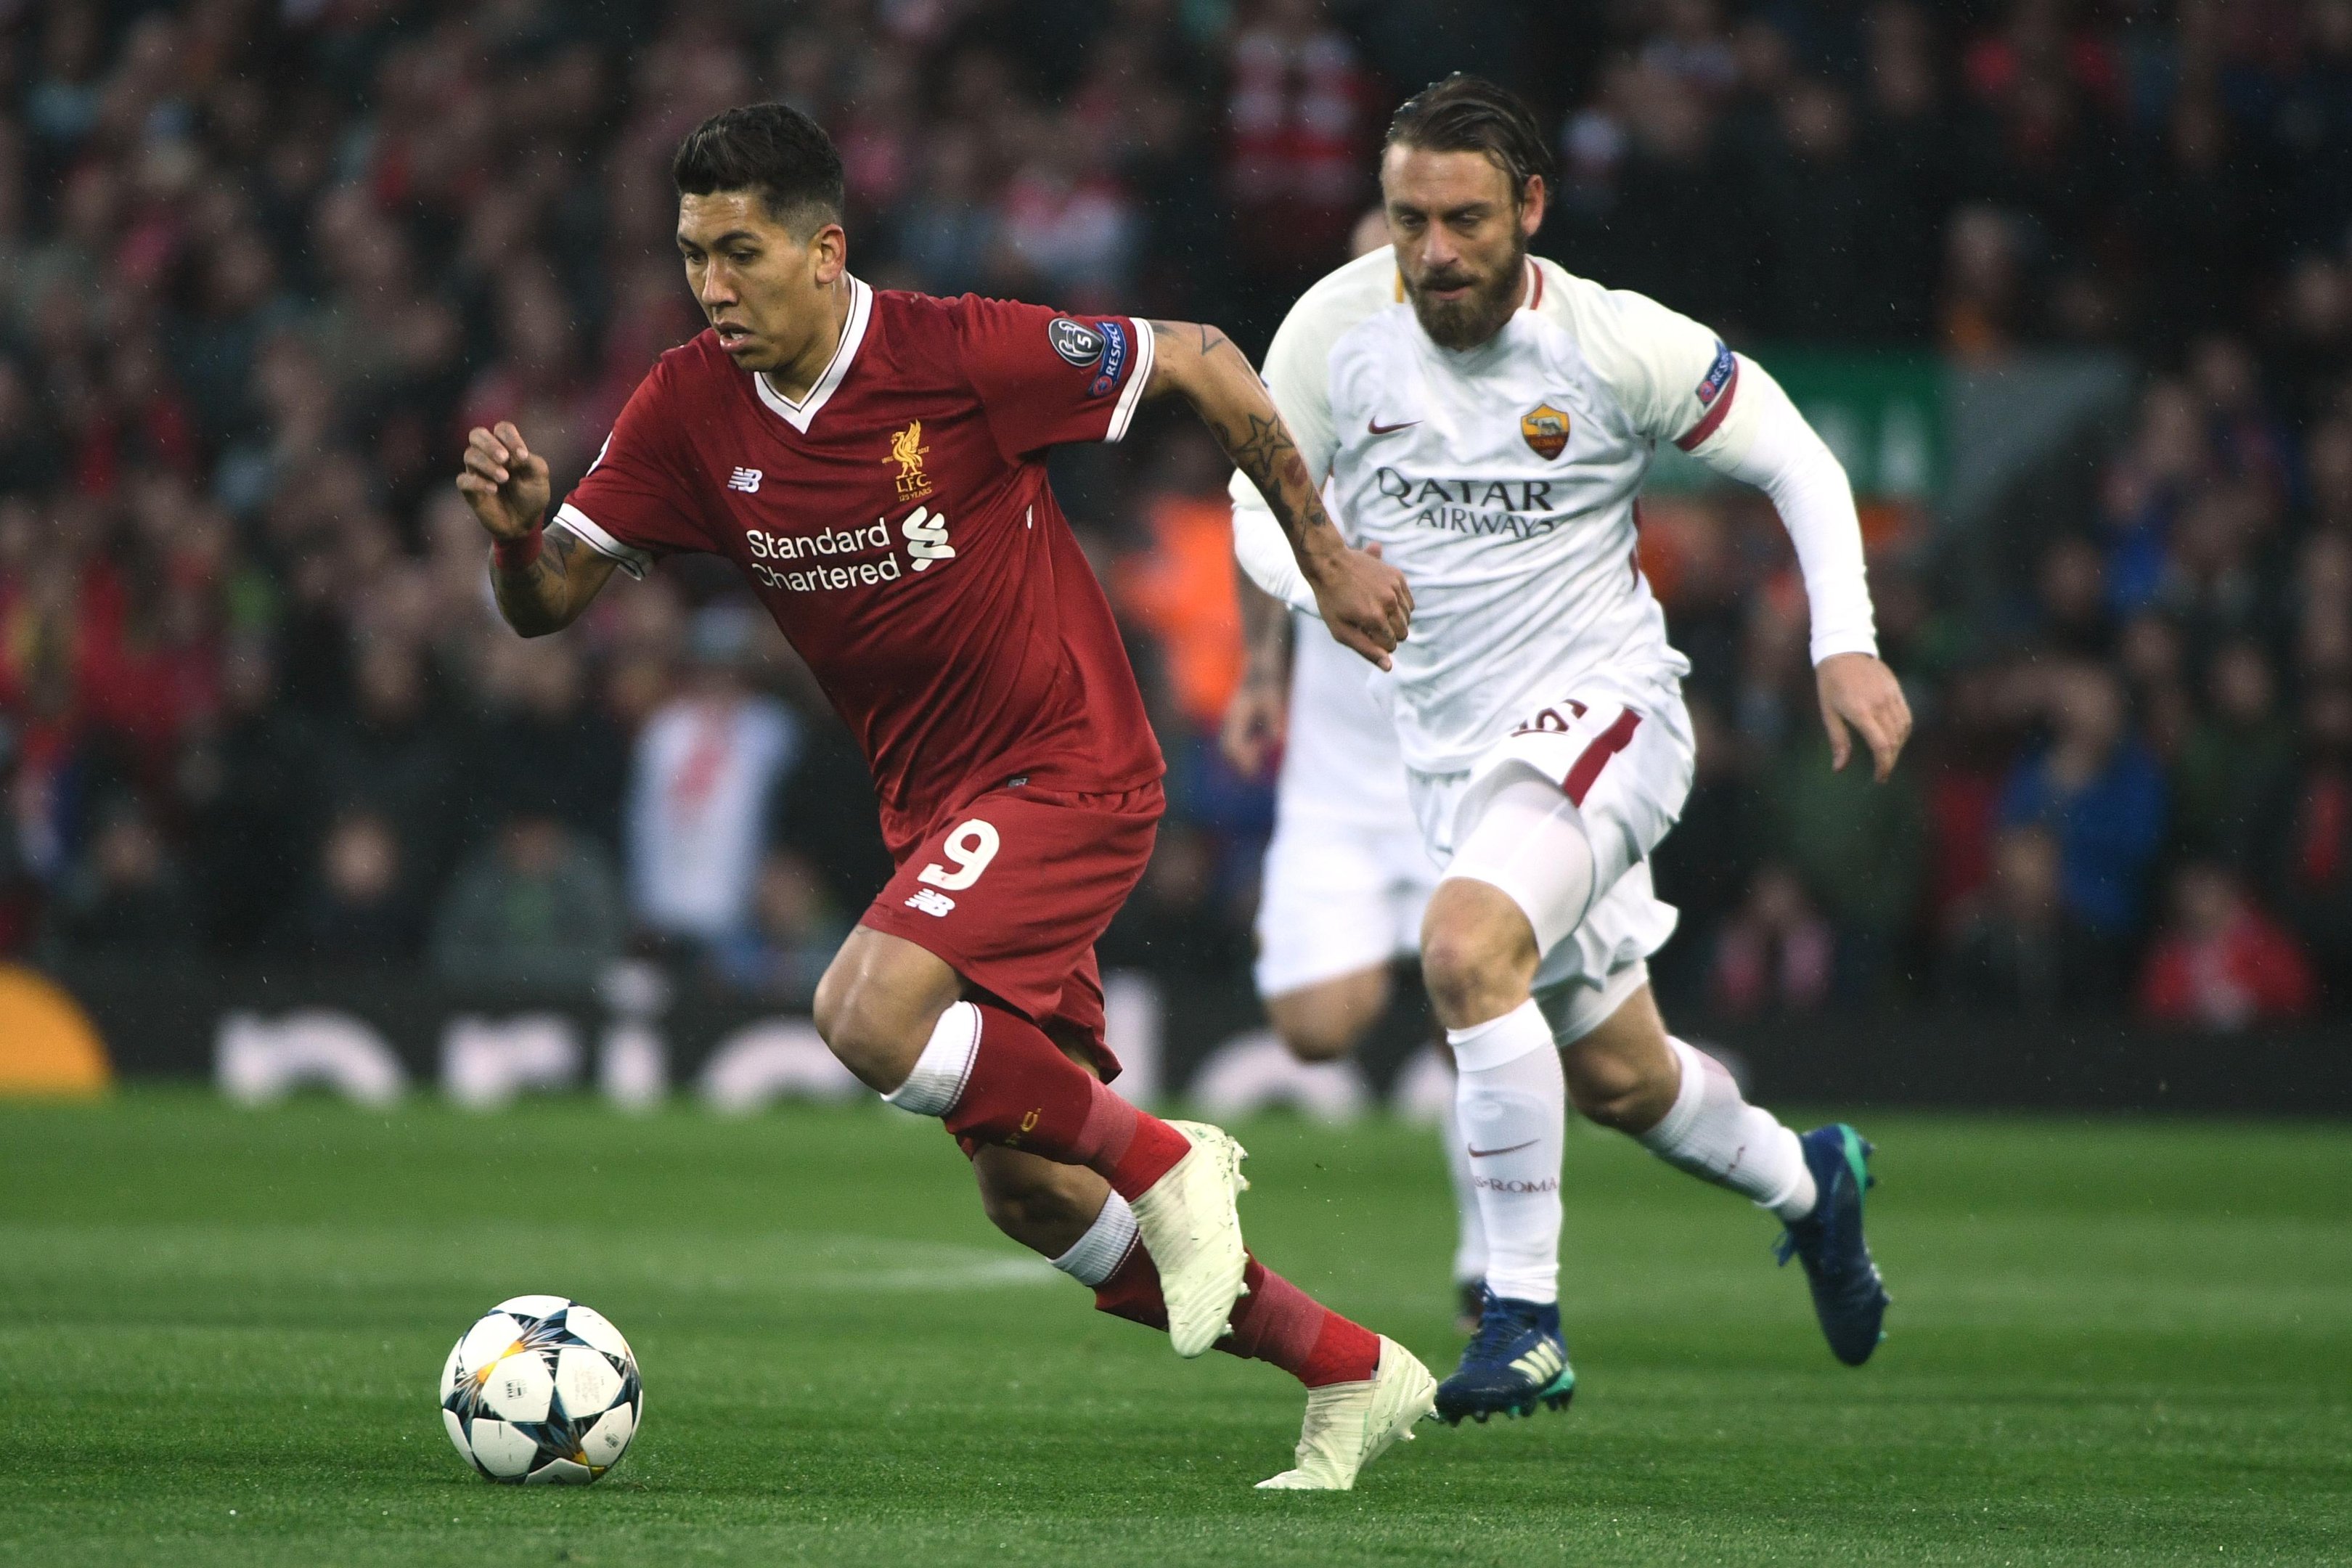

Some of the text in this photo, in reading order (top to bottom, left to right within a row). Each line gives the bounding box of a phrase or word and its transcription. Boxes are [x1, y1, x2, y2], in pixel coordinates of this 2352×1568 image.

[1077, 334, 1092, 348] 5
[1103, 322, 1121, 376] RESPECT
[1377, 467, 1554, 511] QATAR
[746, 517, 891, 559] Standard
[751, 552, 902, 592] Chartered
[918, 818, 1000, 891] 9
